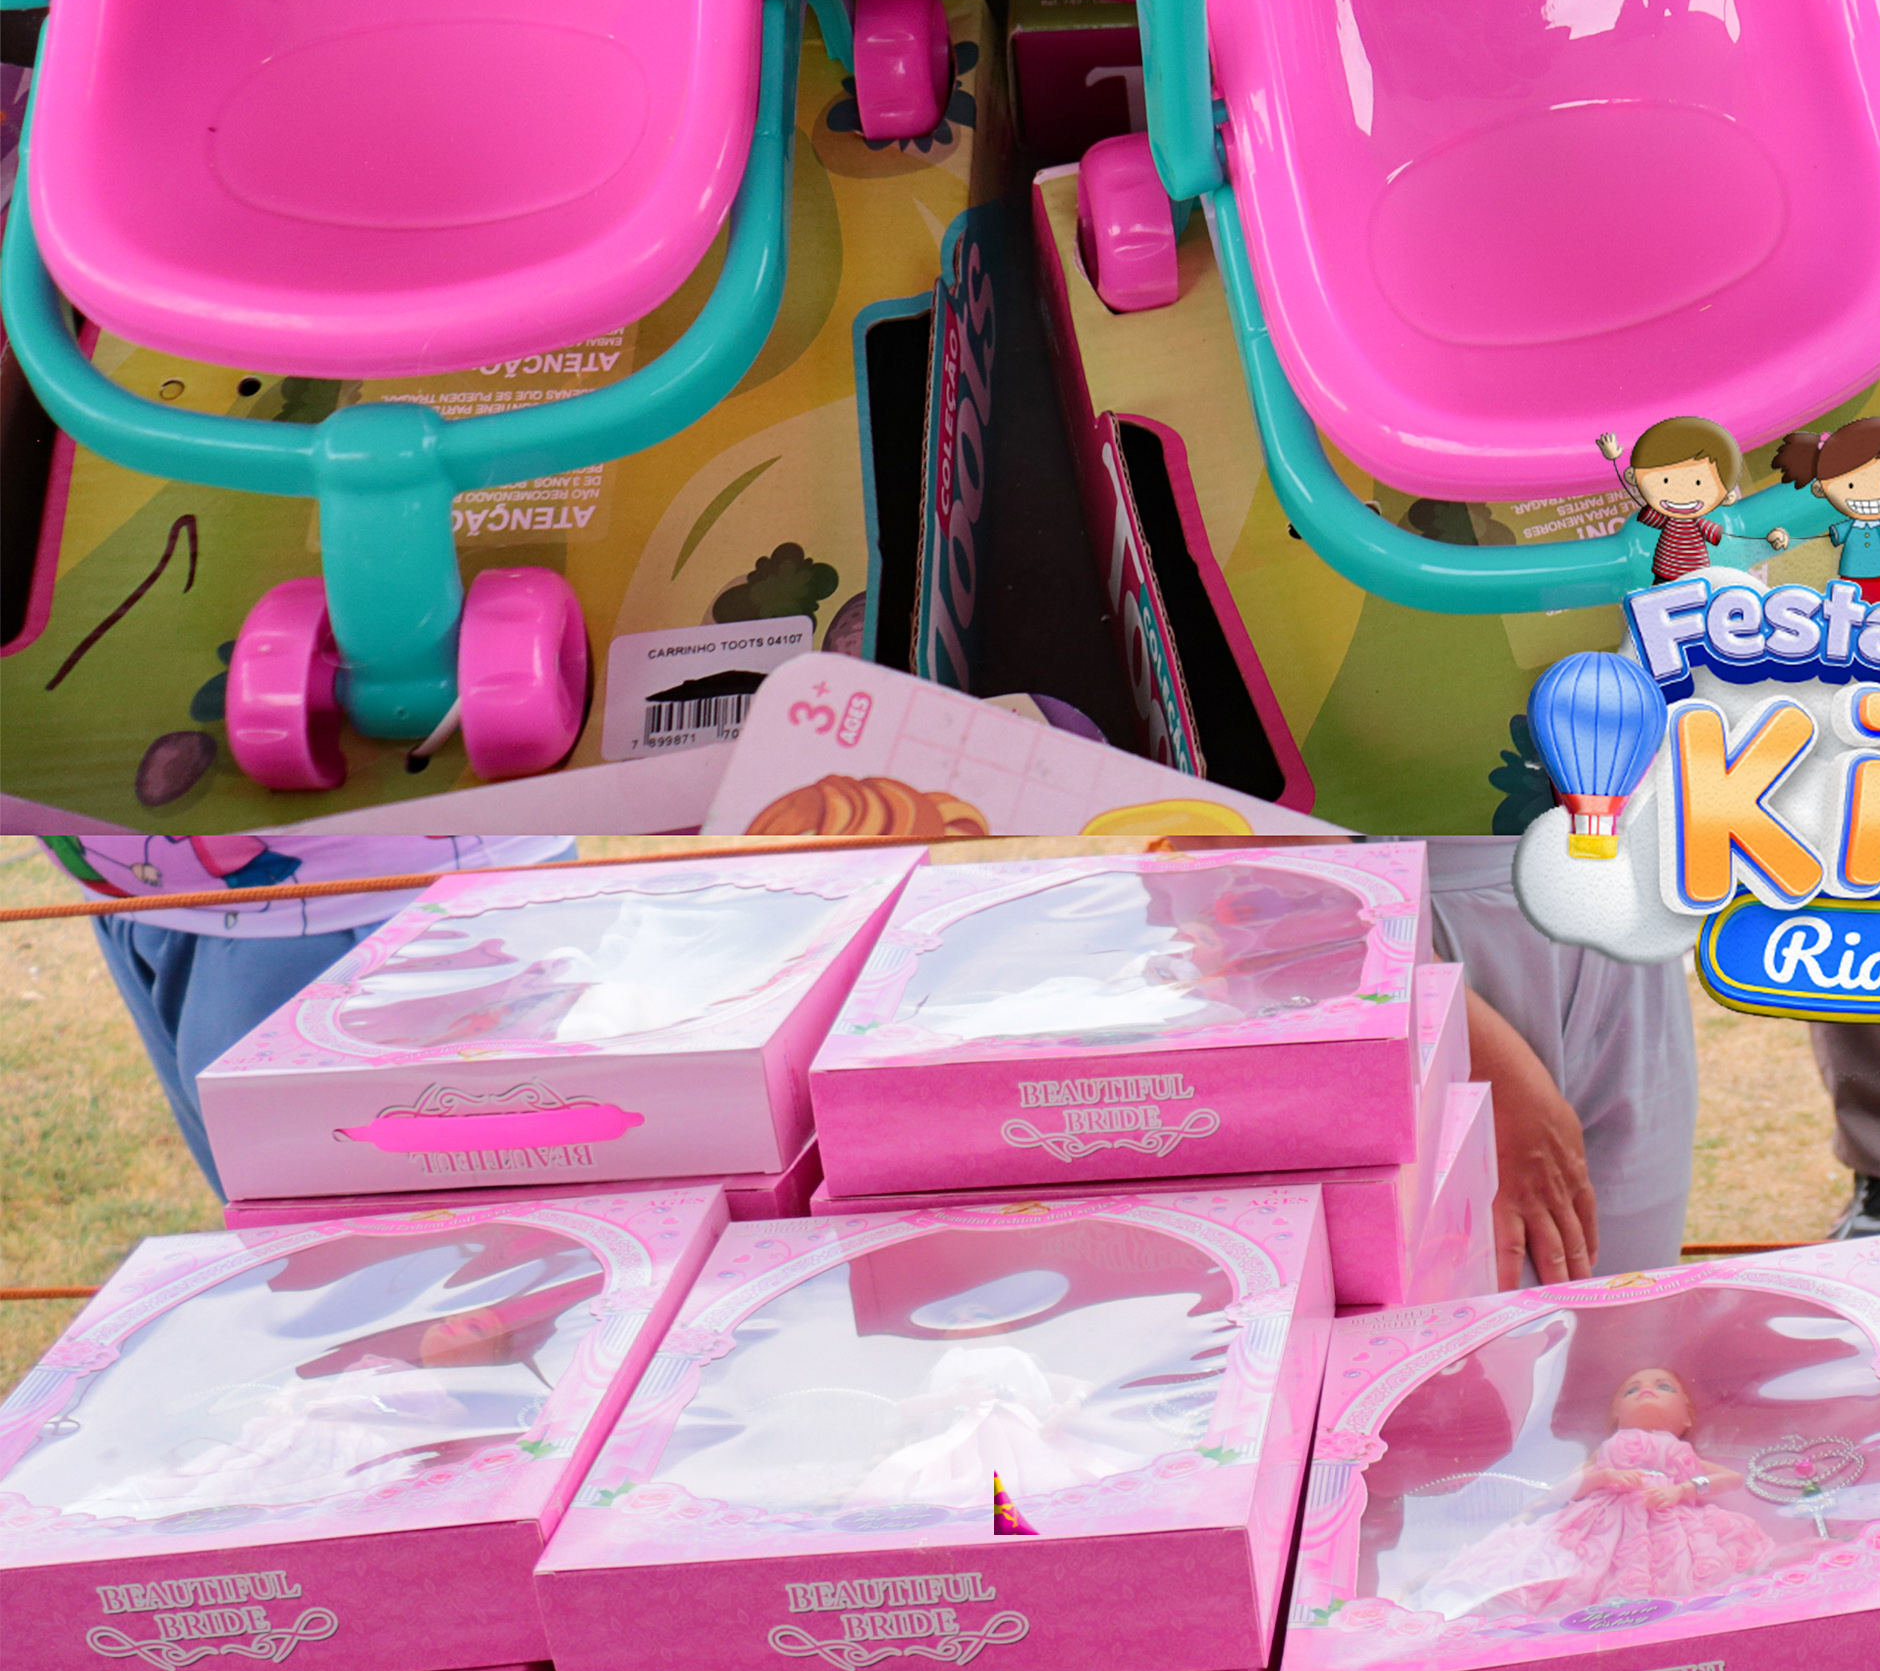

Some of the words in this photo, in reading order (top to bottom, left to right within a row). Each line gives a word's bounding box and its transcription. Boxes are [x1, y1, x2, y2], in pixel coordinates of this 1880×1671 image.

[940, 328, 958, 516] COLEÇÃO
[647, 640, 717, 661] CARRINHO
[720, 637, 764, 652] TOOTS
[766, 633, 804, 649] 04107
[788, 680, 836, 735] 3+
[839, 693, 871, 746] AGES
[649, 732, 697, 749] 899871
[1017, 1073, 1195, 1110] BEAUTIFUL
[1061, 1103, 1163, 1134] BRIDE
[96, 1571, 304, 1616] BEAUTIFUL
[786, 1571, 996, 1614] BEAUTIFUL
[157, 1607, 271, 1643] BRIDE
[842, 1606, 959, 1643] BRIDE
